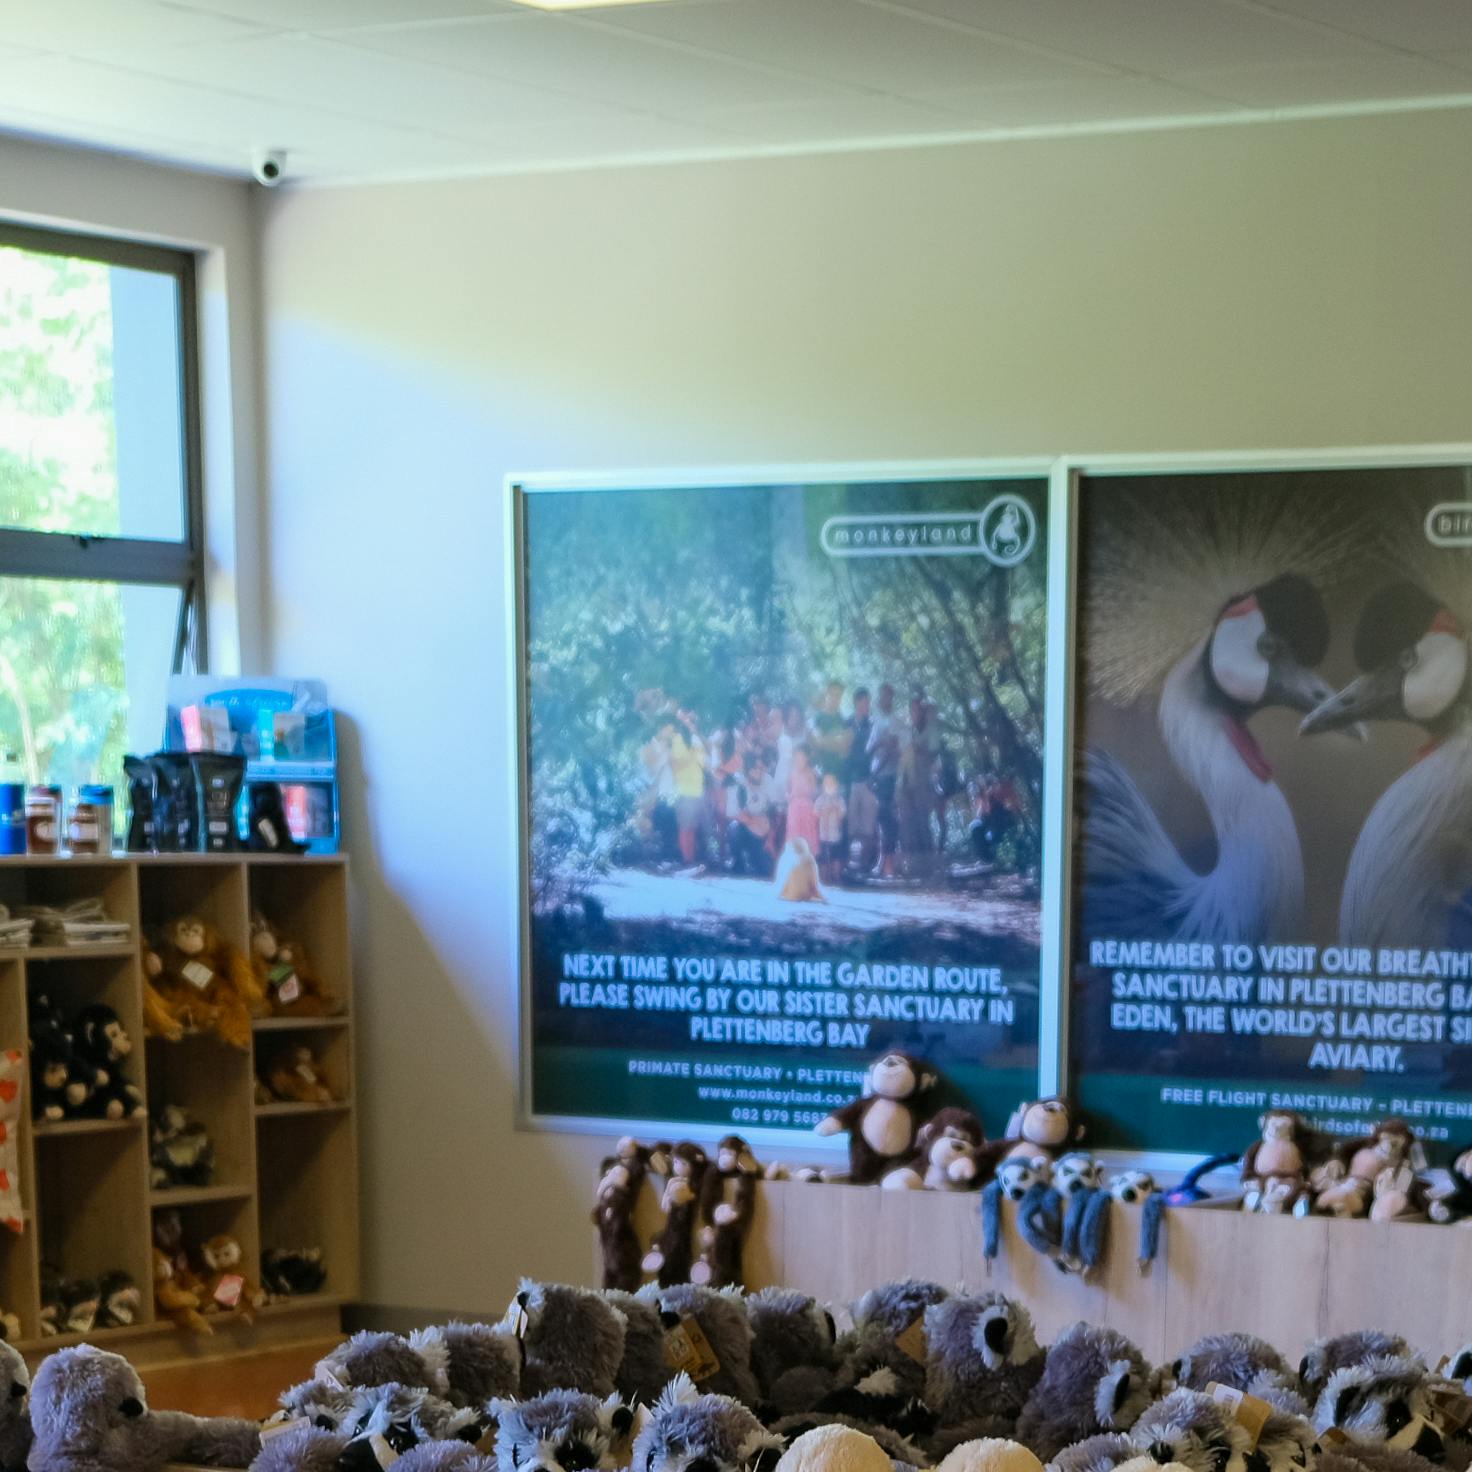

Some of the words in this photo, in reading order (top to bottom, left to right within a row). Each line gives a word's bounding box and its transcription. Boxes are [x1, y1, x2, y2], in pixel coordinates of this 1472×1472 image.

[834, 523, 973, 546] monkeyland
[1089, 941, 1215, 968] REMEMBER
[1221, 943, 1254, 971] TO
[1257, 945, 1317, 972] VISIT
[1321, 947, 1372, 974] OUR
[563, 954, 615, 978] NEXT
[621, 955, 668, 981] TIME
[673, 957, 715, 982] YOU
[720, 959, 762, 984] ARE
[767, 961, 790, 984] IN
[794, 961, 831, 985] THE
[838, 962, 929, 990] GARDEN
[934, 966, 1008, 995] ROUTE,
[1112, 972, 1253, 1001] SANCTUARY
[1257, 976, 1284, 1003] IN
[1289, 977, 1445, 1009] PLETTENBERG
[559, 982, 629, 1008] PLEASE
[633, 984, 702, 1012] SWING
[705, 987, 731, 1012] BY
[736, 989, 779, 1014] OUR
[784, 991, 848, 1016] SISTER
[853, 993, 985, 1022] SANCTUARY
[989, 999, 1015, 1024] IN
[690, 1016, 824, 1046] PLETTENBERG
[827, 1023, 870, 1048] BAY
[1111, 1003, 1178, 1033] EDEN,
[1183, 1005, 1225, 1032] THE
[1230, 1007, 1336, 1037] WORLD'S
[1341, 1011, 1446, 1042] LARGEST
[628, 1059, 690, 1076] PRIMATE
[694, 1062, 782, 1081] SANCTUARY
[1308, 1042, 1404, 1072] AVIARY.
[731, 1107, 759, 1122] 082
[763, 1108, 789, 1123] 979
[1160, 1087, 1203, 1104] FREE
[1207, 1089, 1267, 1107] FLIGHT
[1271, 1092, 1373, 1112] SANCTUARY
